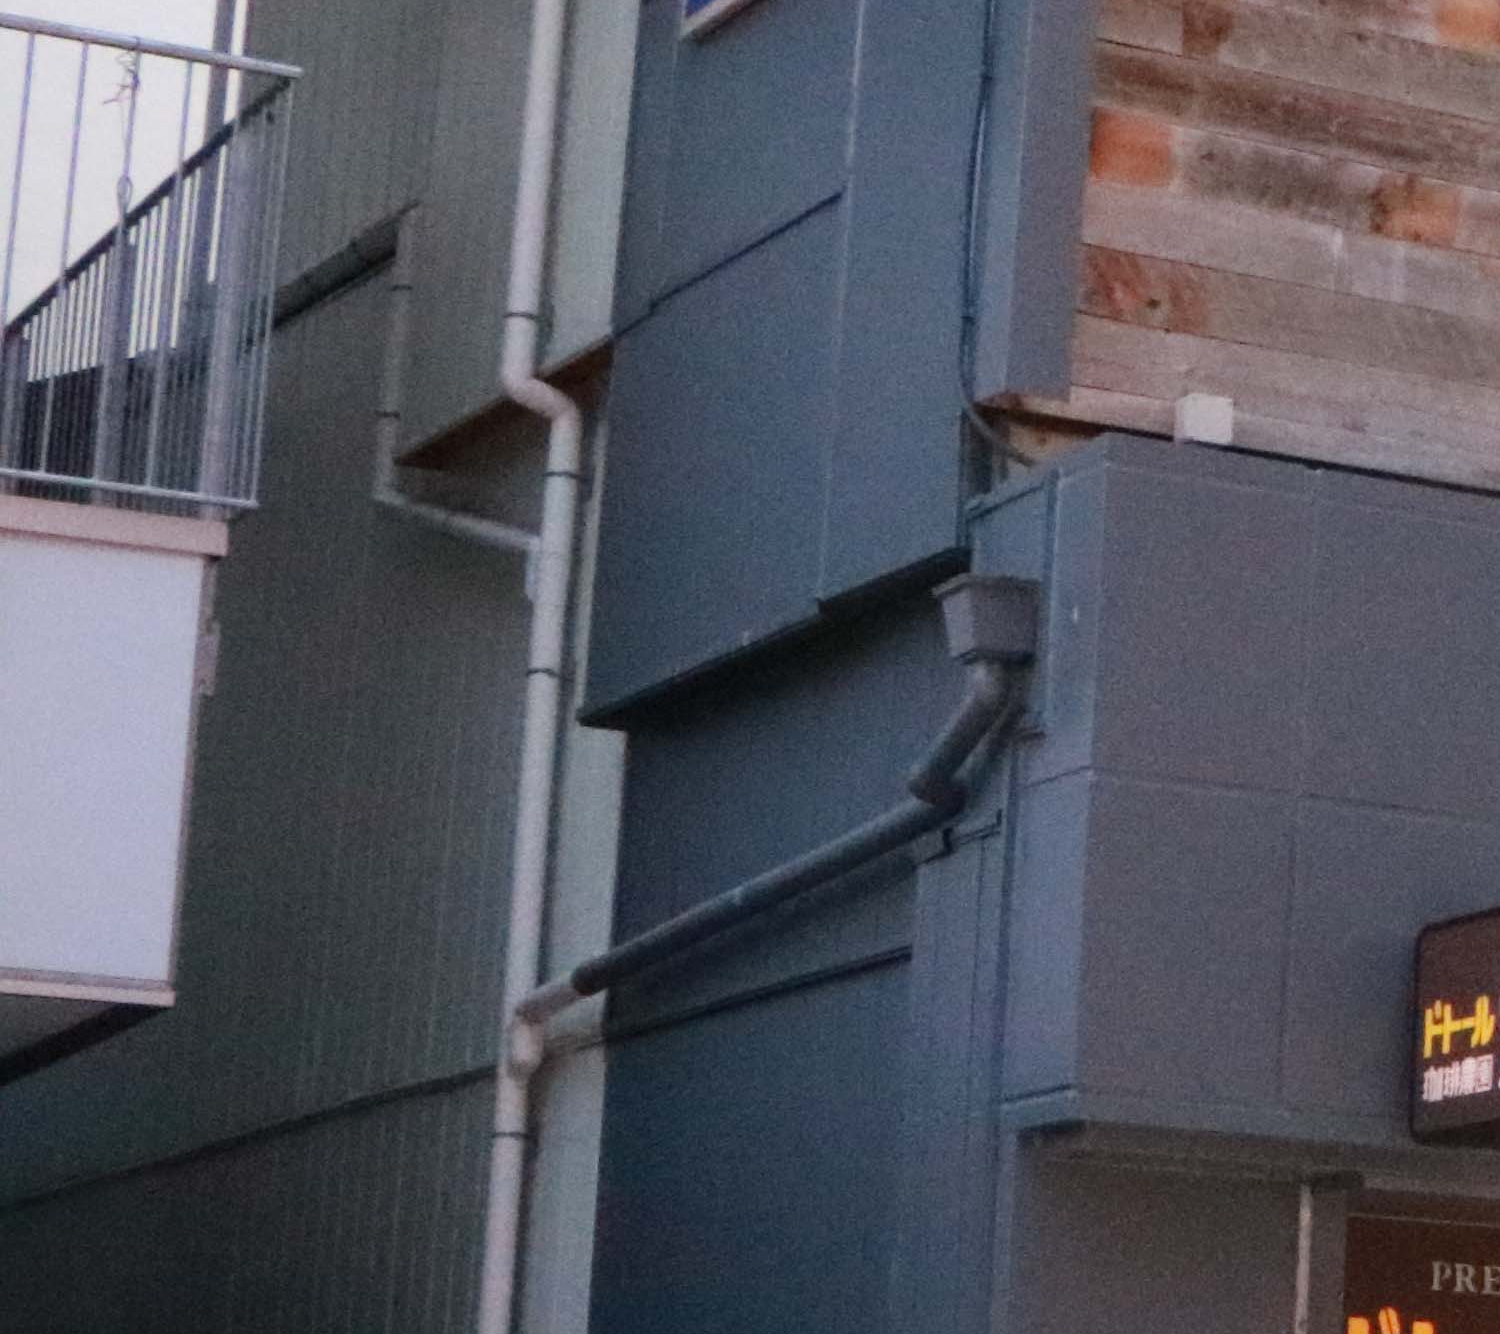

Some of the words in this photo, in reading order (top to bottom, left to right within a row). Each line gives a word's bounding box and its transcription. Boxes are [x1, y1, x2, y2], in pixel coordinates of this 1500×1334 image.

[1421, 995, 1495, 1058] ドトール
[1421, 1054, 1495, 1102] 珈琲農園
